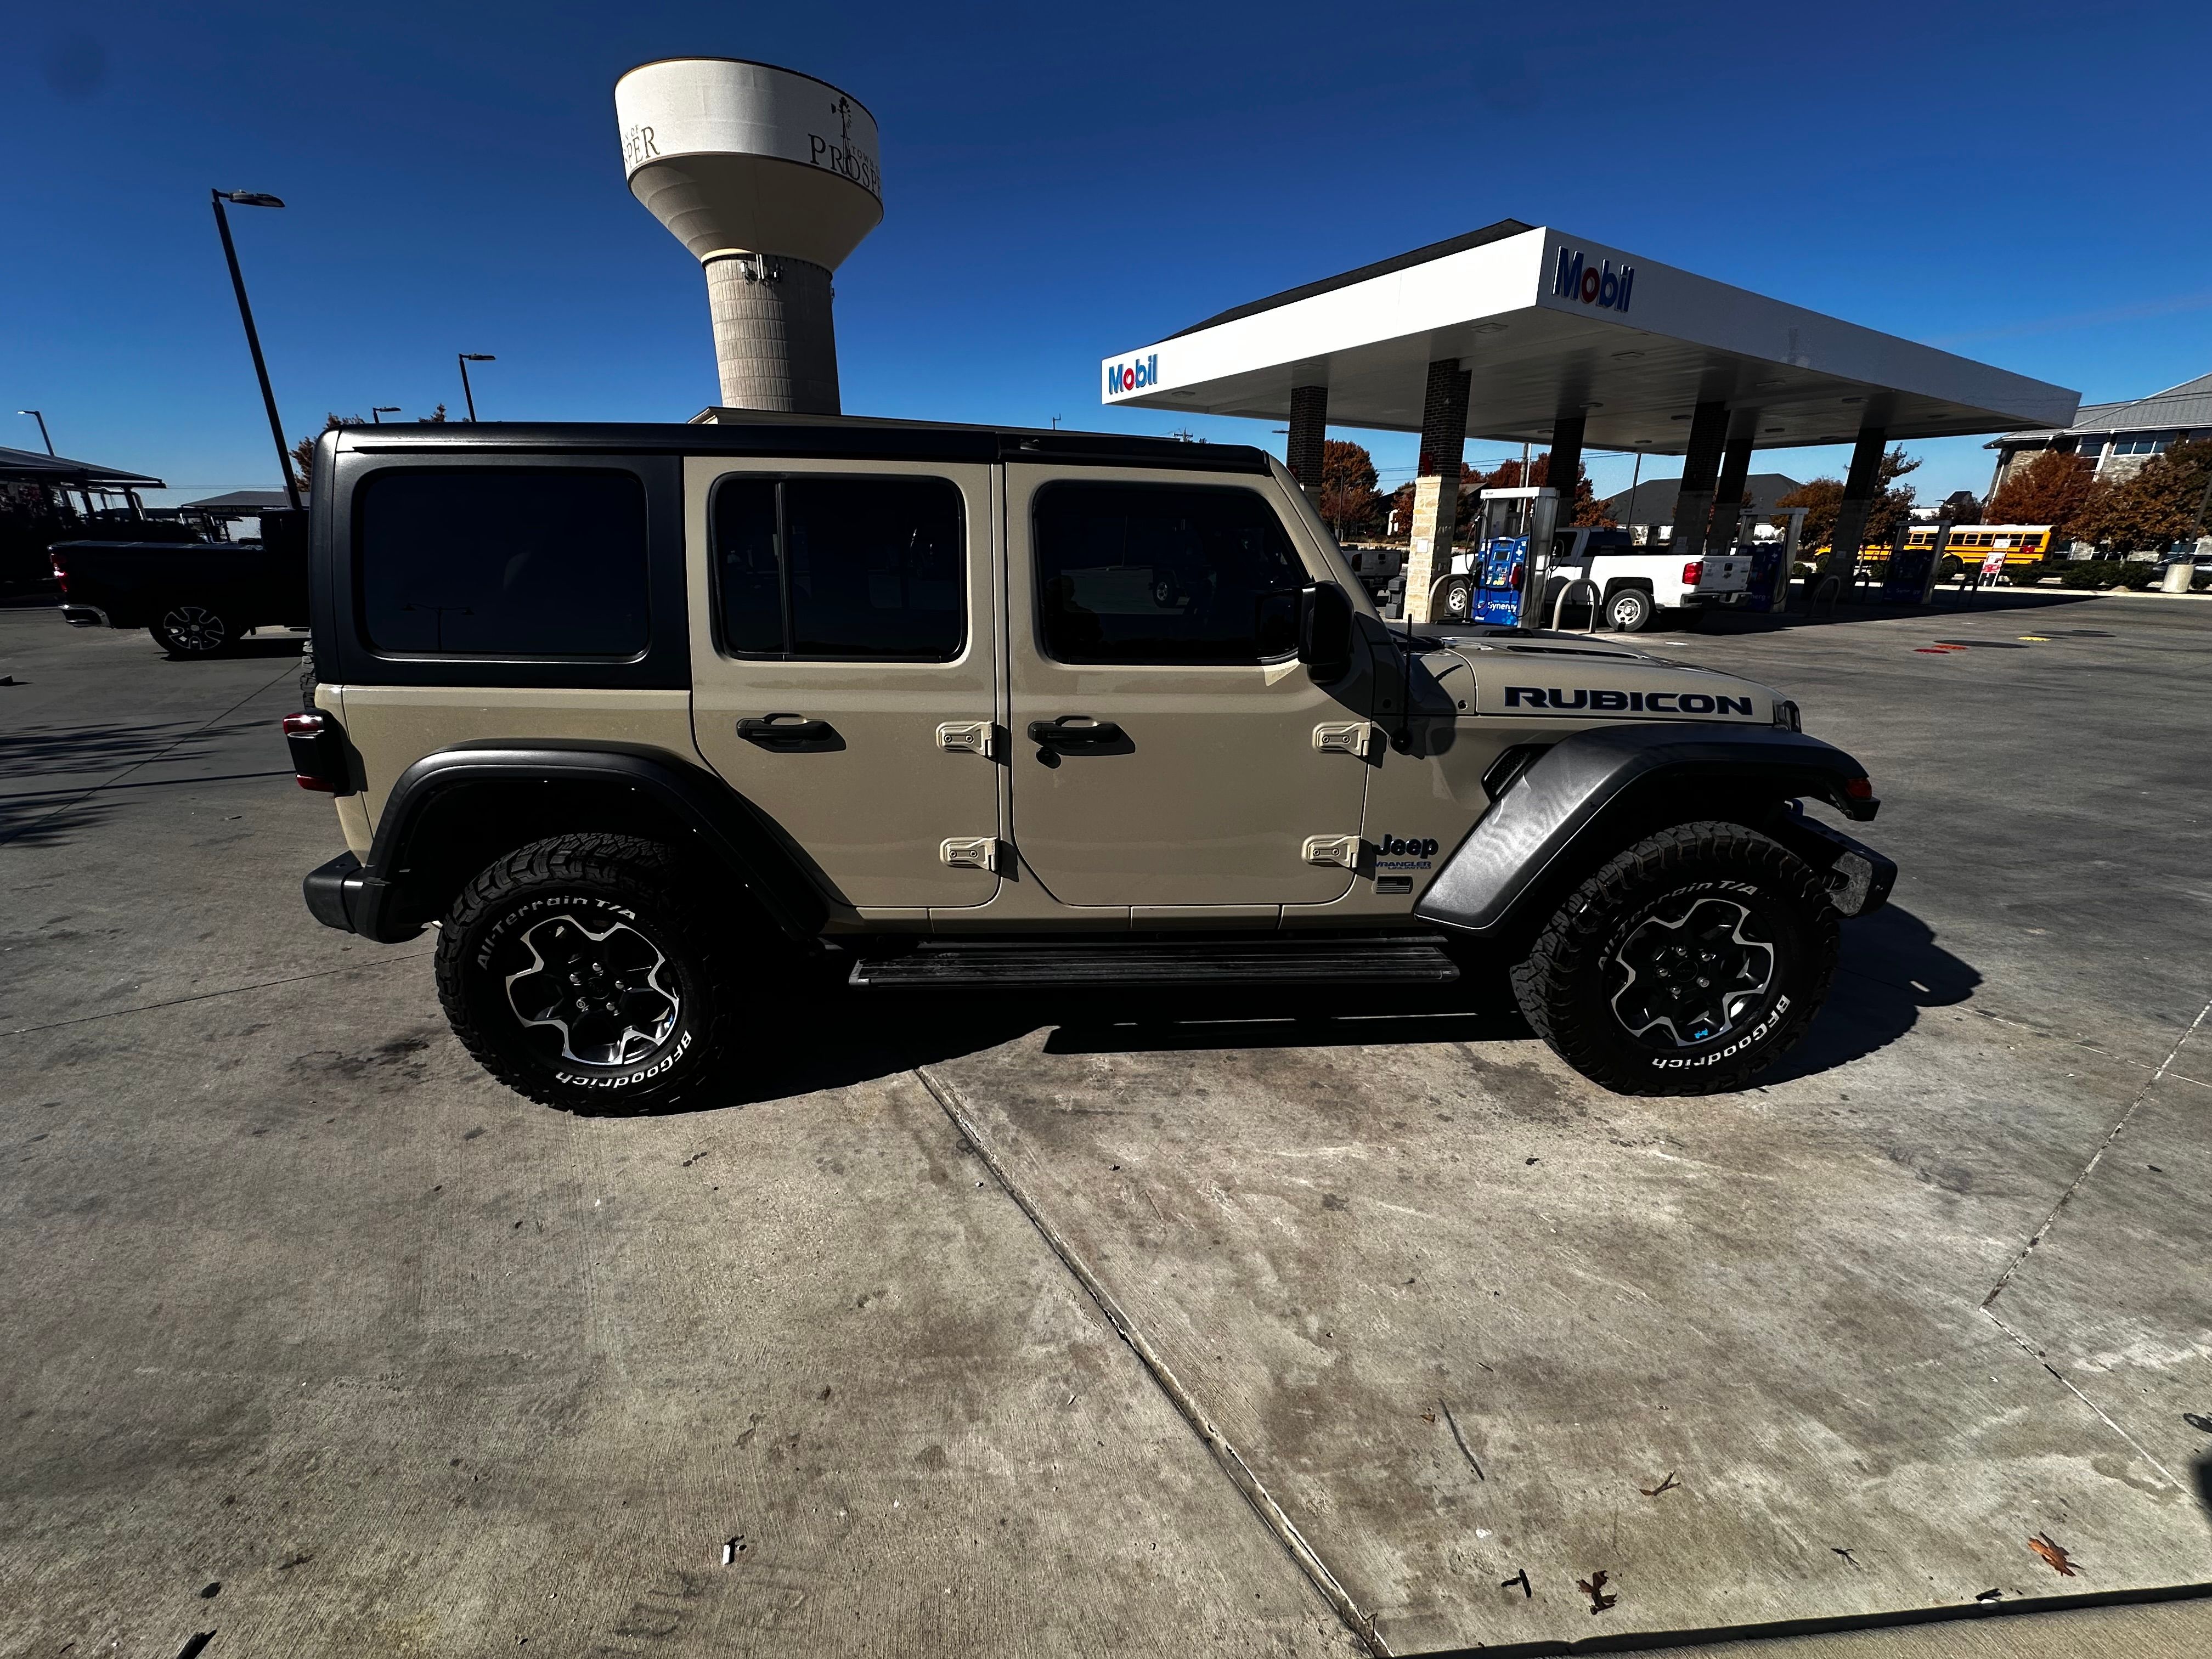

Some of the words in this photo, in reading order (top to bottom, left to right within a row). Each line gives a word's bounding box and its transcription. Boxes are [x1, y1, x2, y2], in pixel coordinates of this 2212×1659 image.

[1552, 246, 1635, 313] Mobil
[1109, 354, 1158, 395] Mobil
[1504, 686, 1753, 715] RUBICON
[1372, 833, 1438, 859] Jeep
[1718, 880, 1758, 896] T/A
[477, 895, 588, 970] All-Terrain
[595, 898, 636, 921] T/A
[1652, 994, 1791, 1070] BFGoodrich
[555, 1029, 692, 1089] BFGoodrich
